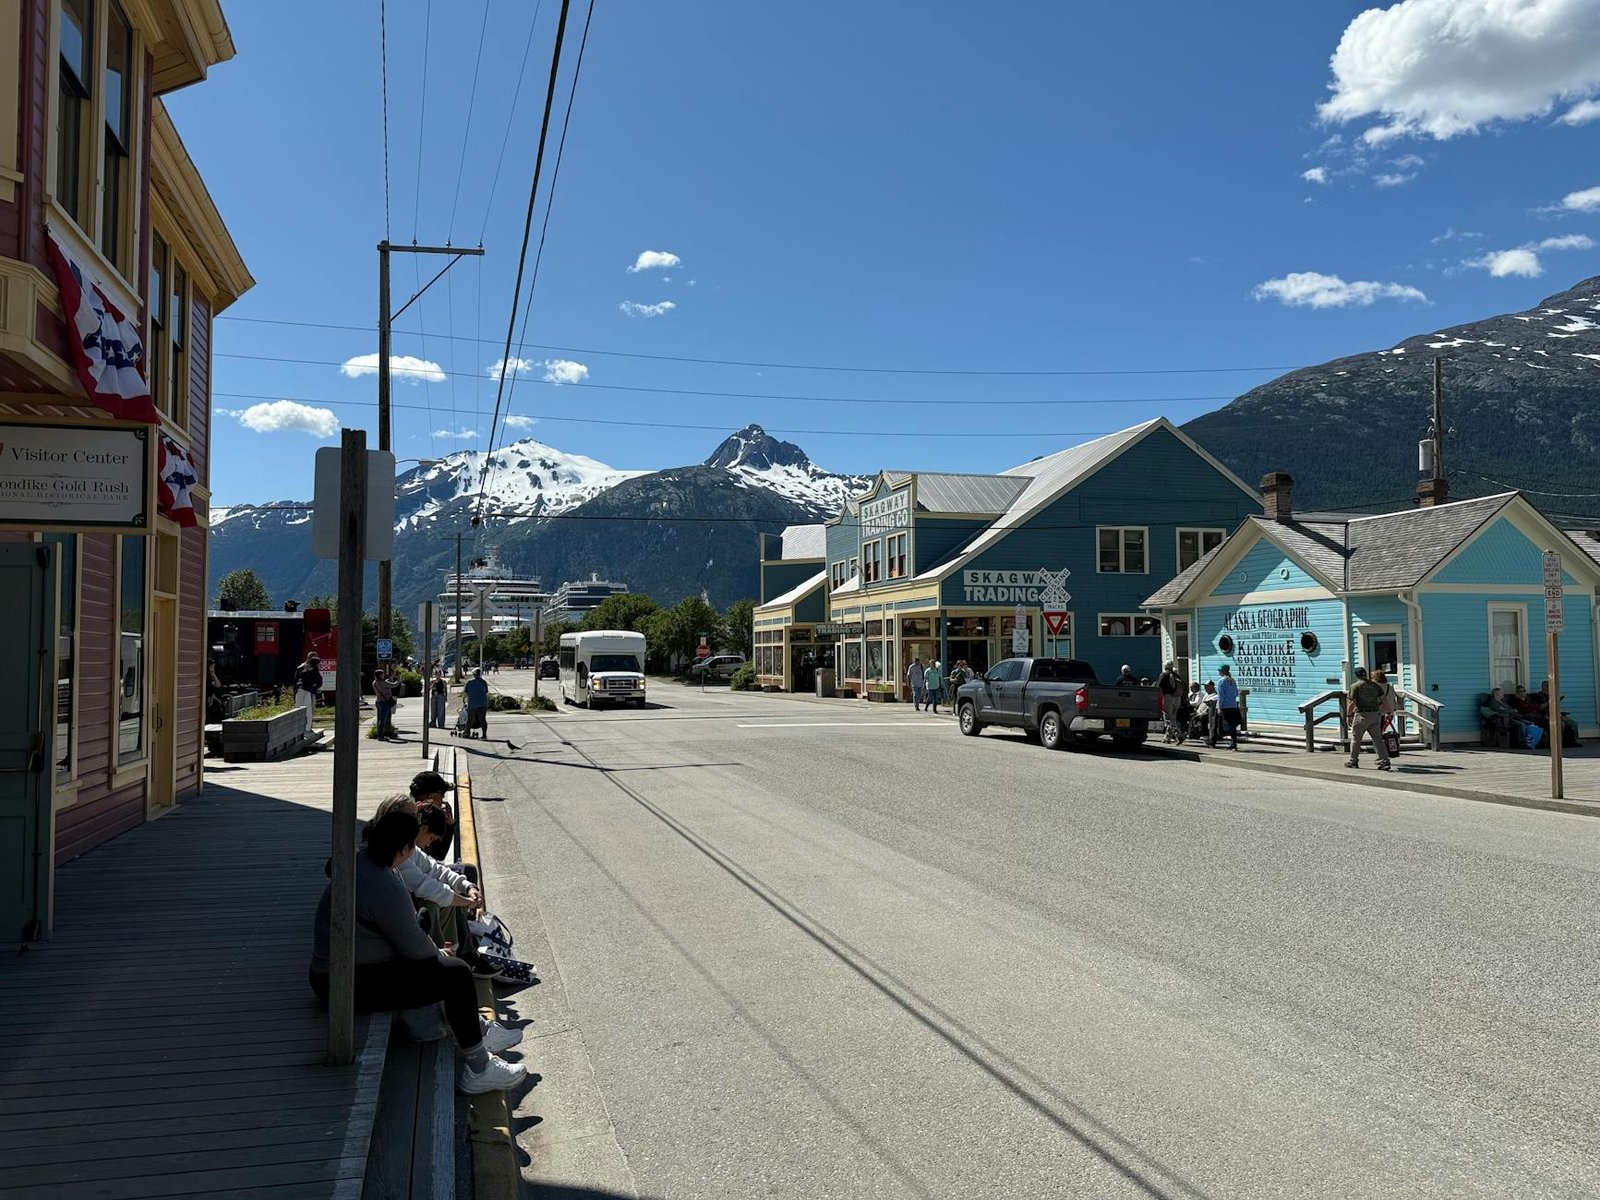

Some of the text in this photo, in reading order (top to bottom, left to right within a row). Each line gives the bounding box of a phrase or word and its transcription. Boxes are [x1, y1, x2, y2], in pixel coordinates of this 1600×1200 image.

[10, 447, 129, 466] Visitor Center
[53, 480, 86, 492] Gold
[94, 481, 129, 493] Rush
[37, 491, 98, 500] HISTORICAL
[863, 493, 906, 519] SKAGWAY
[861, 509, 909, 538] TRADING CO
[1039, 568, 1053, 585] RAIL
[1055, 586, 1070, 601] ROAD
[1040, 569, 1070, 601] CROSSING
[963, 587, 1040, 602] TRADING
[1223, 606, 1310, 632] ALASKA GEOGRAPHIC
[1237, 640, 1295, 656] KLONDIKE
[1237, 656, 1295, 664] GOLD RUSH
[1238, 666, 1296, 678] NATIONAL
[1237, 677, 1296, 686] HISTORICAL PARK
